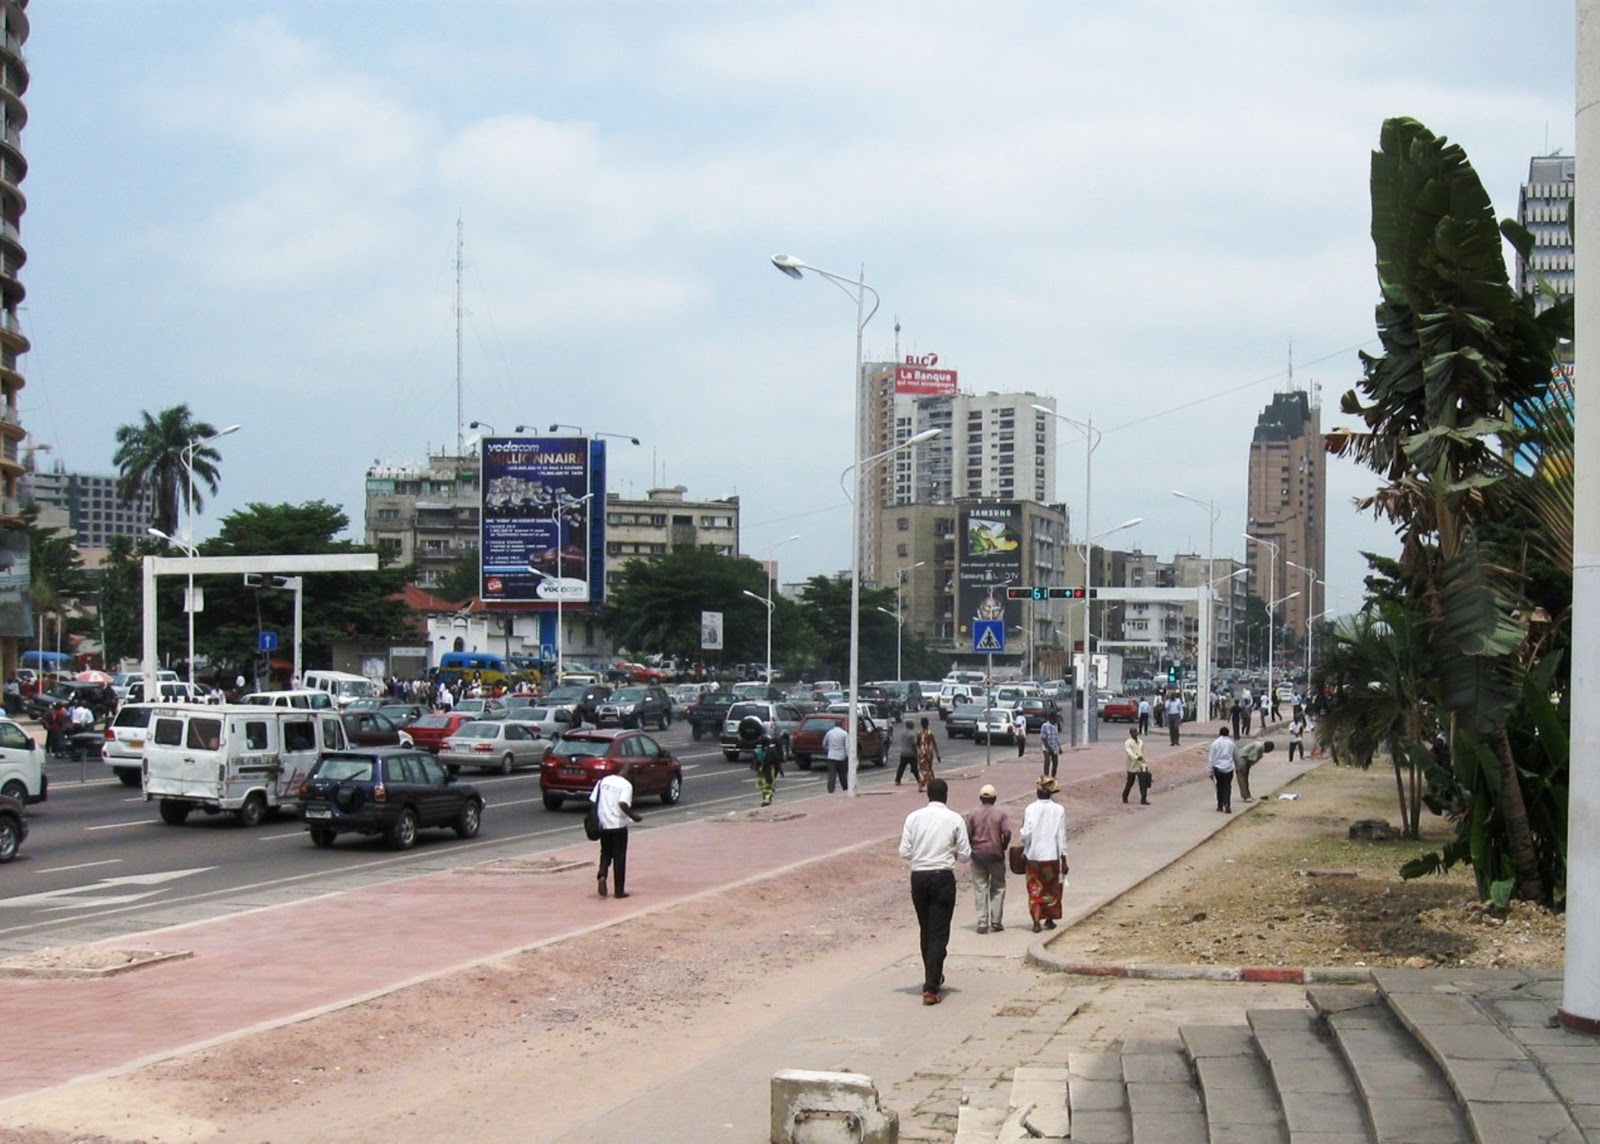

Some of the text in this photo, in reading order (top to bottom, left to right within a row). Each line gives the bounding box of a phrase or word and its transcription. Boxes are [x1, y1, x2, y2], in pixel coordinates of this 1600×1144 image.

[900, 370, 951, 382] La Banque
[488, 441, 539, 452] vodacom
[489, 453, 584, 464] MILLIONNAIRE
[970, 509, 1012, 517] SAMSUNG
[1034, 588, 1047, 599] 61
